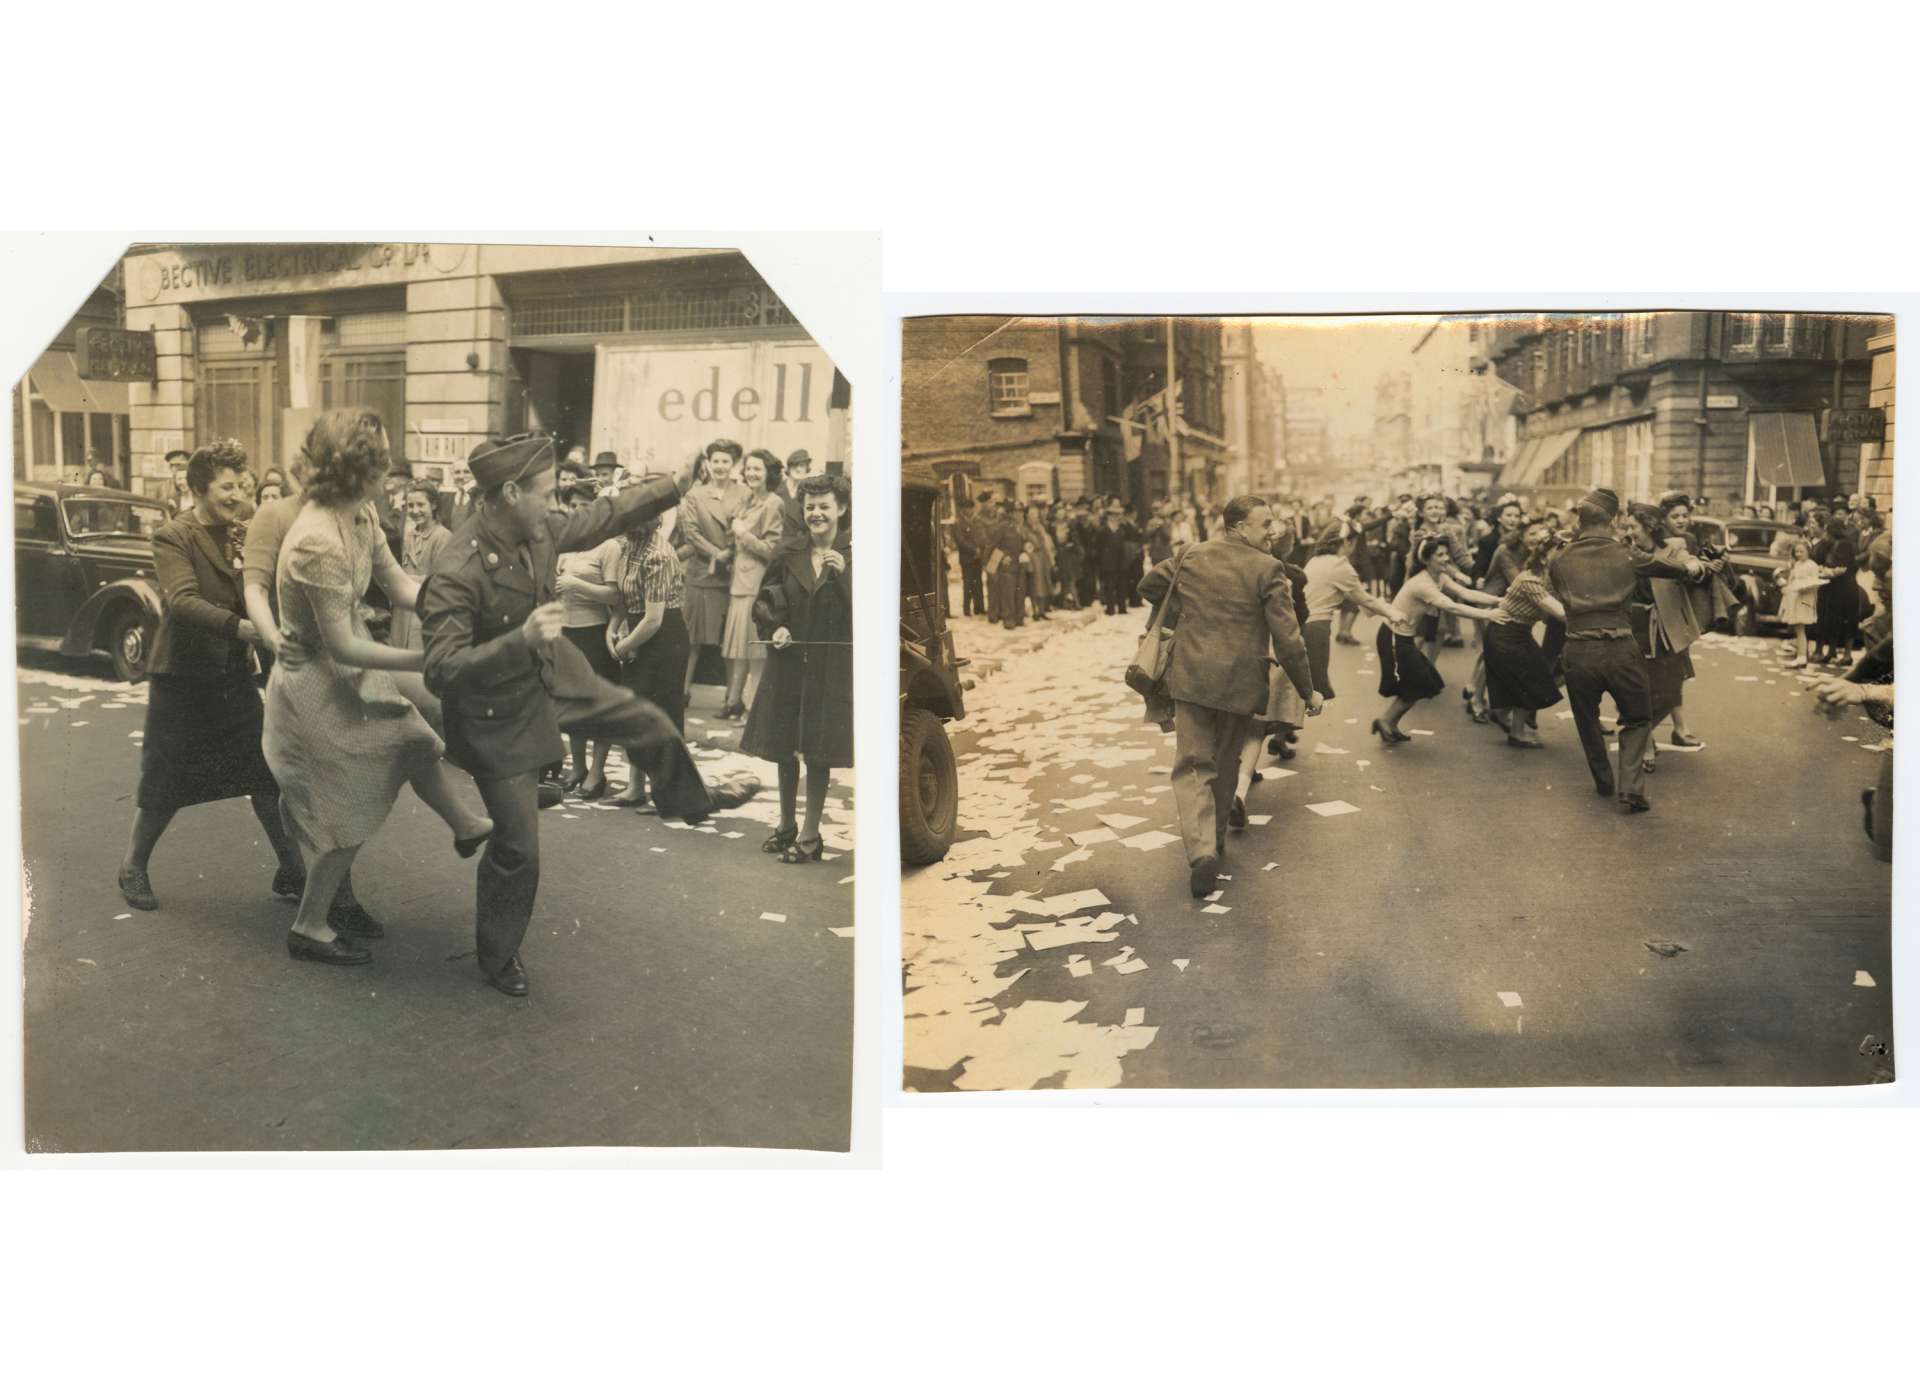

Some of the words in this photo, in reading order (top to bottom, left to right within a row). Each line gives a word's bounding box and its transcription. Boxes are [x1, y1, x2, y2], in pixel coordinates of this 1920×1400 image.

[160, 257, 232, 291] BECTIVE
[244, 246, 361, 282] ELECTRICAL
[657, 362, 832, 423] edell
